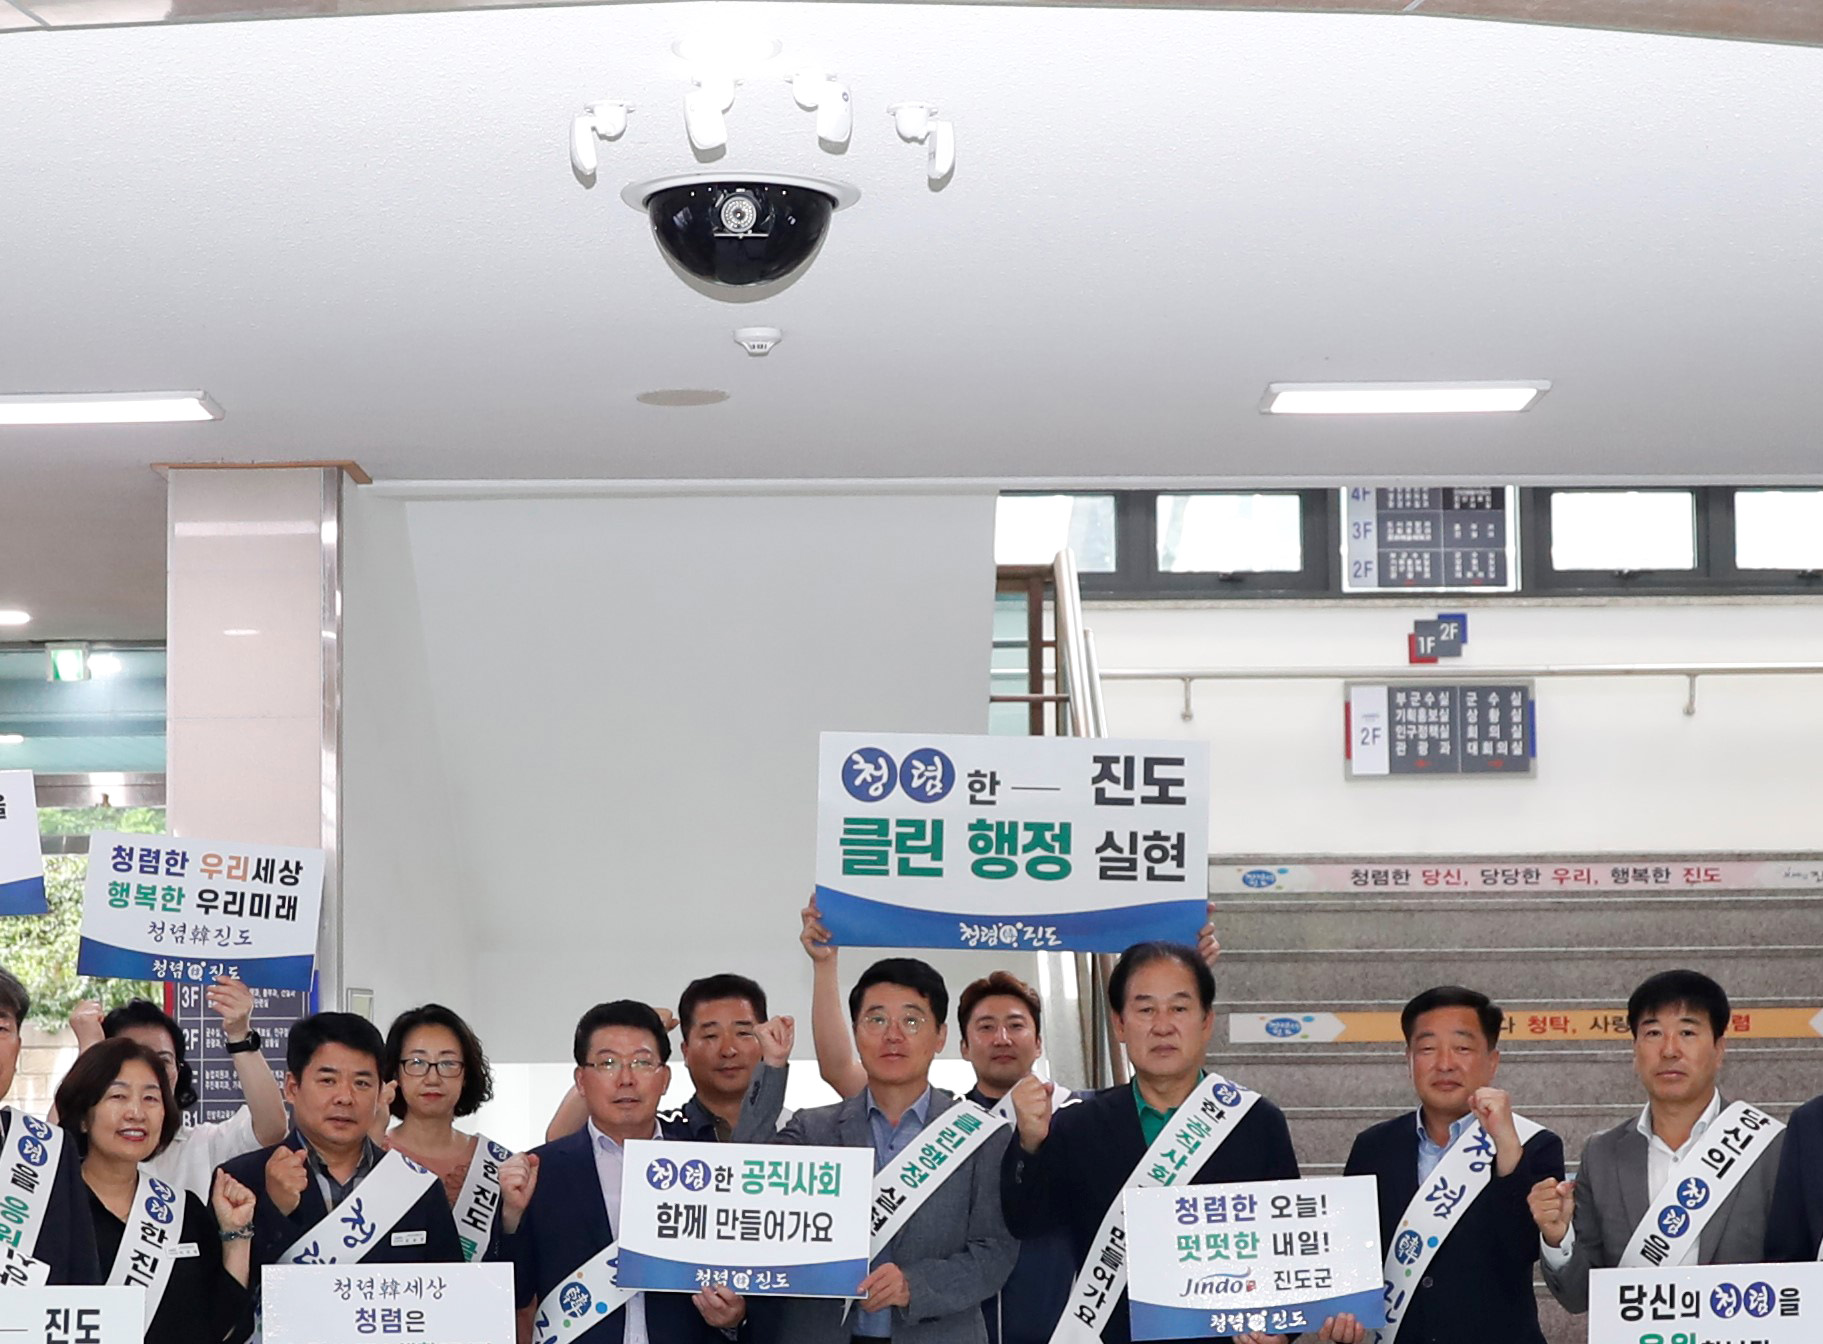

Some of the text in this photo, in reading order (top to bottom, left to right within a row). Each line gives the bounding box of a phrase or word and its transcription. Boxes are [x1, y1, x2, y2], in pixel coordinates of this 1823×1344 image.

[1353, 522, 1372, 539] 3F
[1354, 561, 1373, 578] 2F
[1418, 637, 1436, 654] 1F
[1440, 623, 1458, 641] 2F
[1361, 727, 1381, 746] 2F
[841, 747, 1187, 806] 청렴한 진도
[839, 817, 1186, 882] 클린 행정 실현
[111, 845, 304, 886] 청렴한 우리세상
[1350, 866, 1722, 886] 청렴한 당신, 당당한 우리, 행복한 진도
[107, 880, 298, 922] 행복한 우리미래
[182, 986, 199, 1008] 3F
[1527, 1014, 1577, 1034] 청탁,
[646, 1158, 842, 1197] 청렴한 공직사회
[1640, 1108, 1771, 1266] 당신의 청렴을
[657, 1202, 833, 1242] 함께 만들어가요
[1175, 1194, 1327, 1225] 청렴한 오늘!
[1177, 1231, 1329, 1262] 떳떳한 내일!
[1180, 1268, 1333, 1297] Jindo 진도군
[1619, 1281, 1800, 1322] 당신의 청렴을
[355, 1307, 425, 1334] 청렴은
